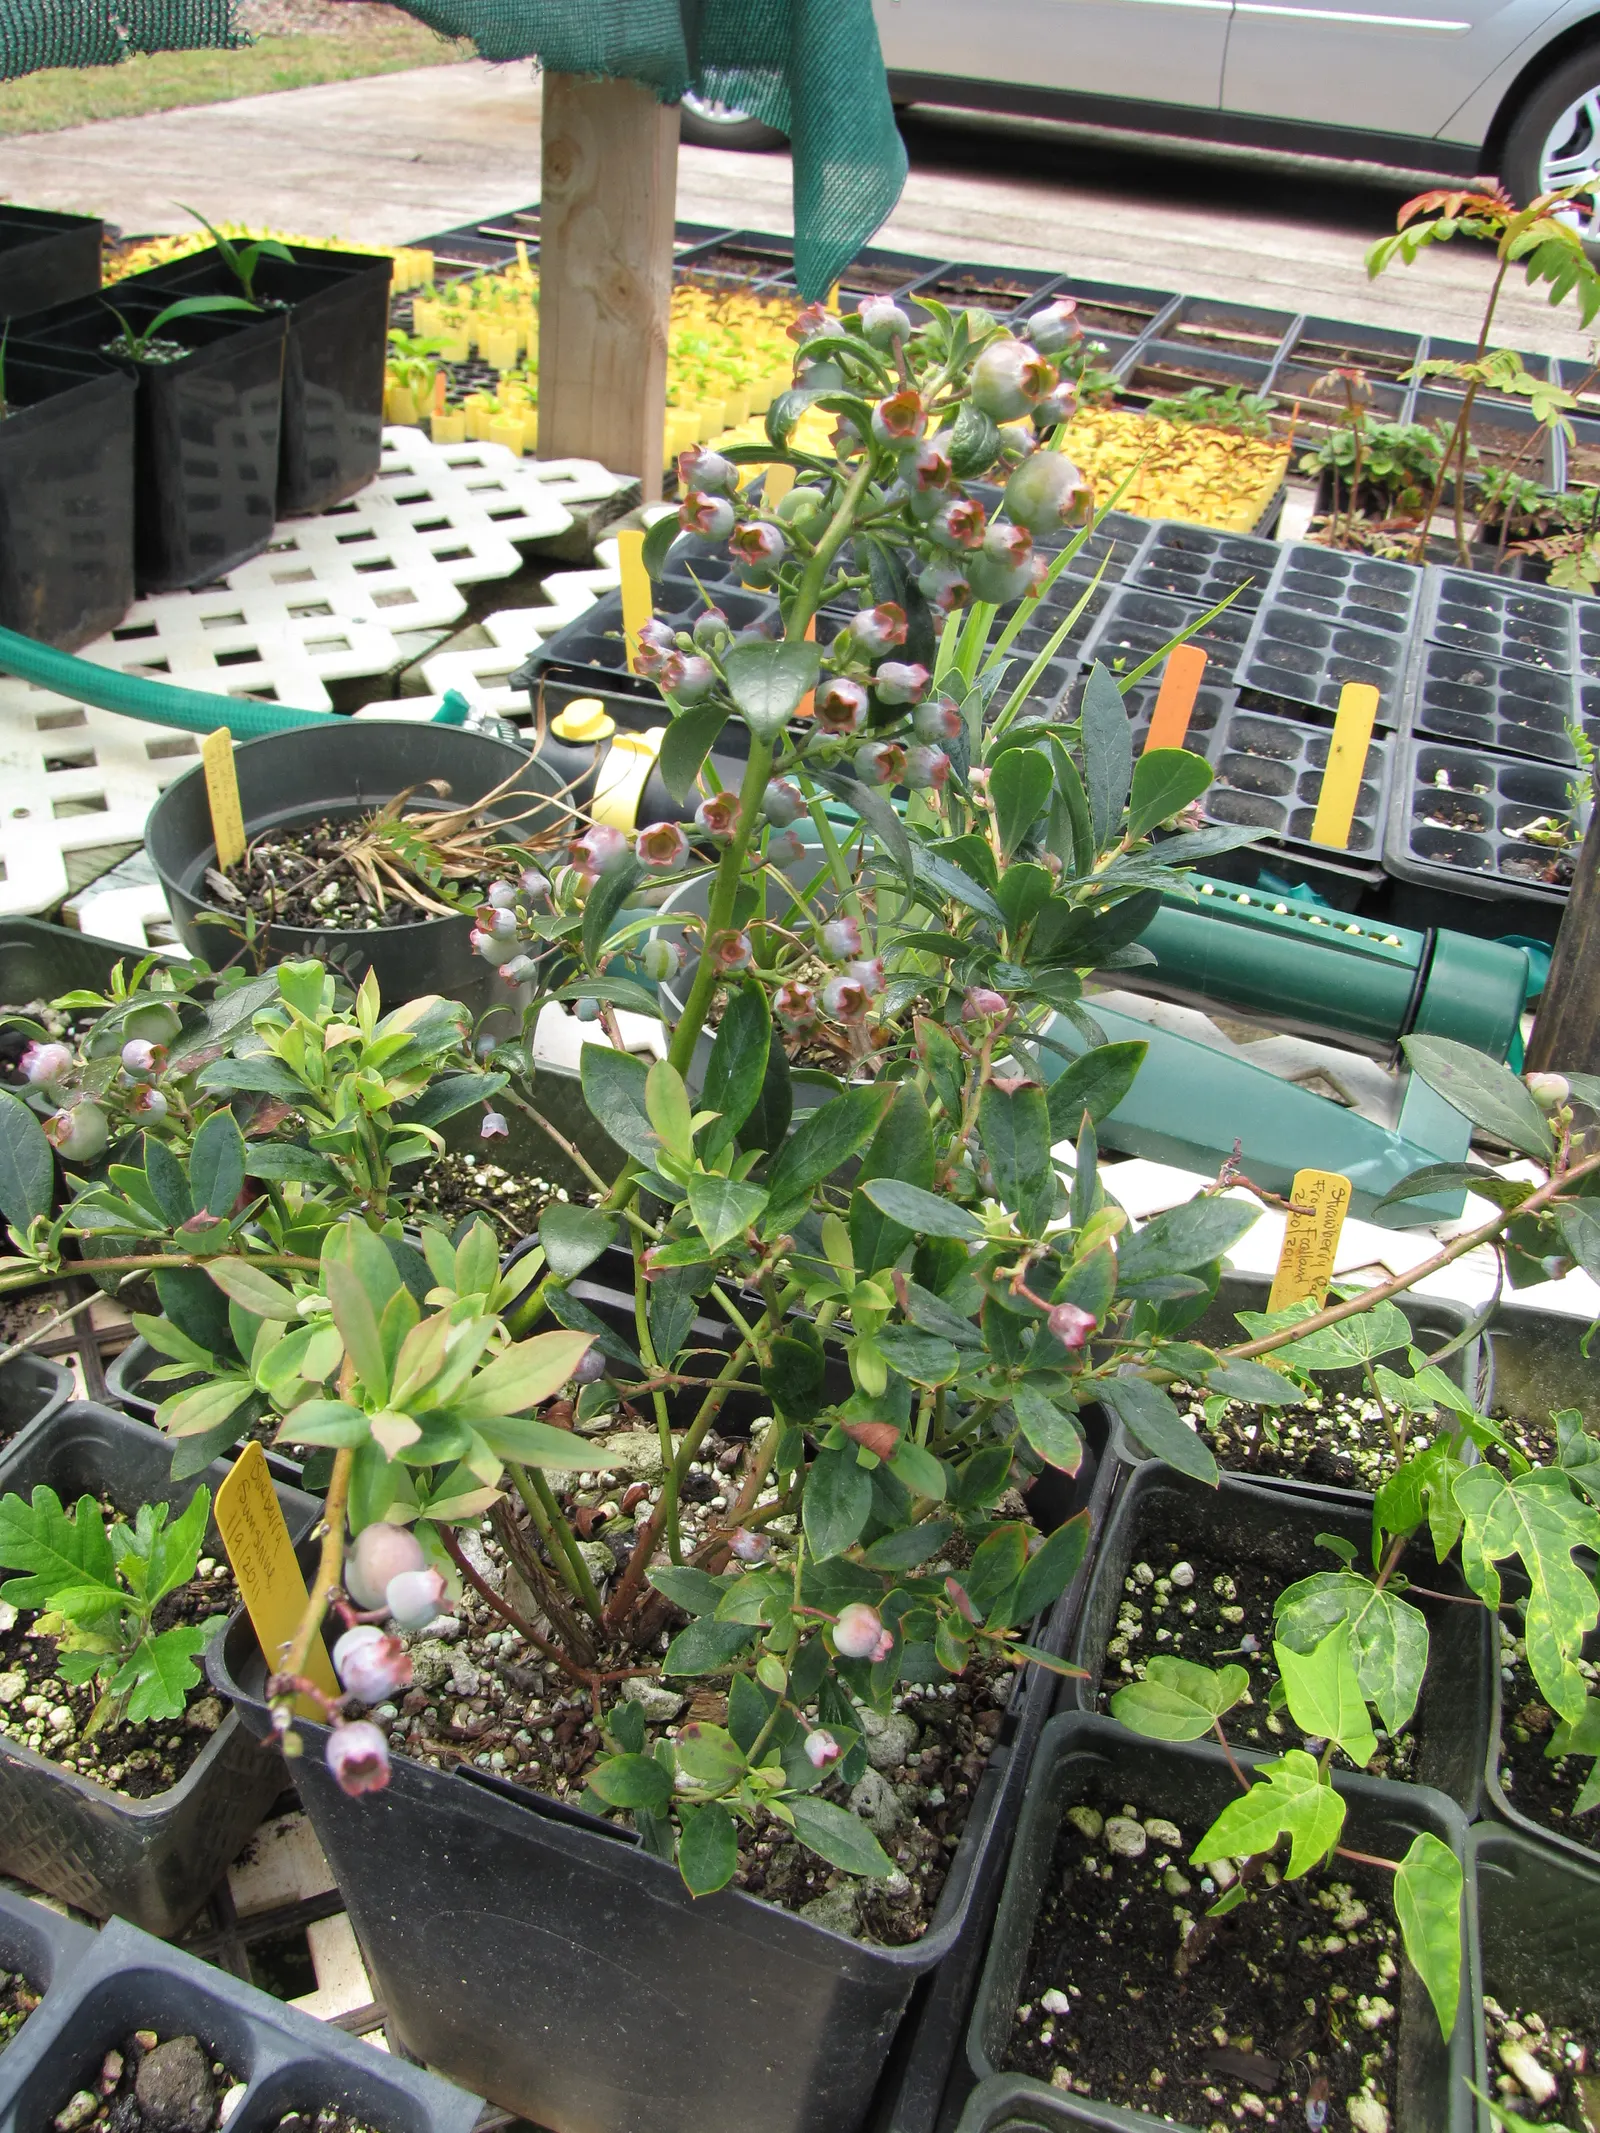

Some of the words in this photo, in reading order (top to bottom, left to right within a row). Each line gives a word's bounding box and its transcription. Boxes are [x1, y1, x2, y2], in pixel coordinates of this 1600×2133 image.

[1307, 1179, 1326, 1223] Fro:
[1309, 1187, 1346, 1268] Strawberry
[250, 1454, 283, 1559] Blueberry
